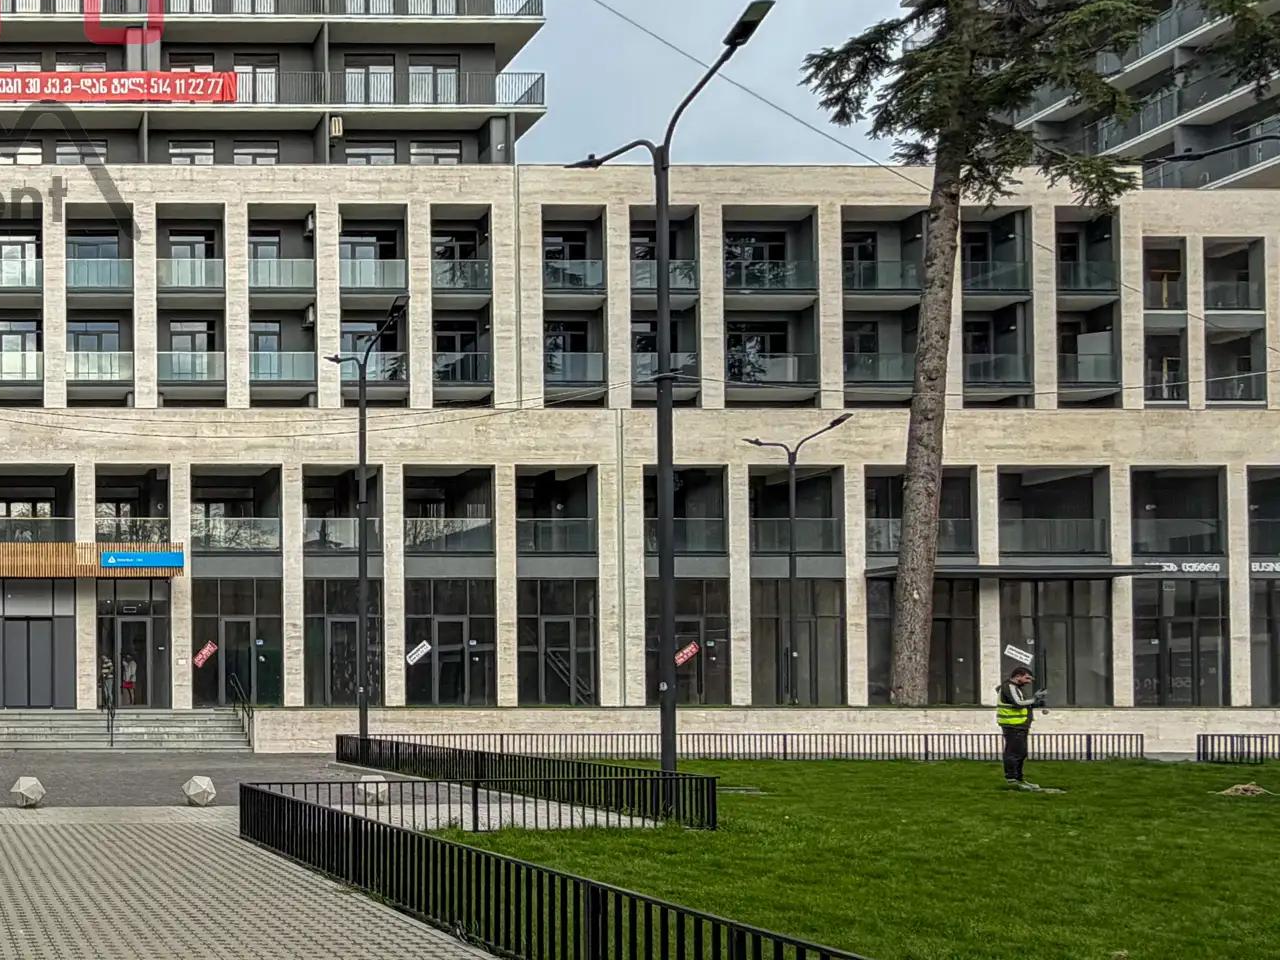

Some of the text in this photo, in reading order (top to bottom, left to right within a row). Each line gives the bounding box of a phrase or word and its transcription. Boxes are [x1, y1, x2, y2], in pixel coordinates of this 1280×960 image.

[25, 78, 41, 94] 30
[111, 77, 148, 94] ტელ:
[150, 77, 172, 94] 514
[174, 78, 185, 94] 11
[188, 78, 204, 94] 22
[207, 78, 224, 94] 77
